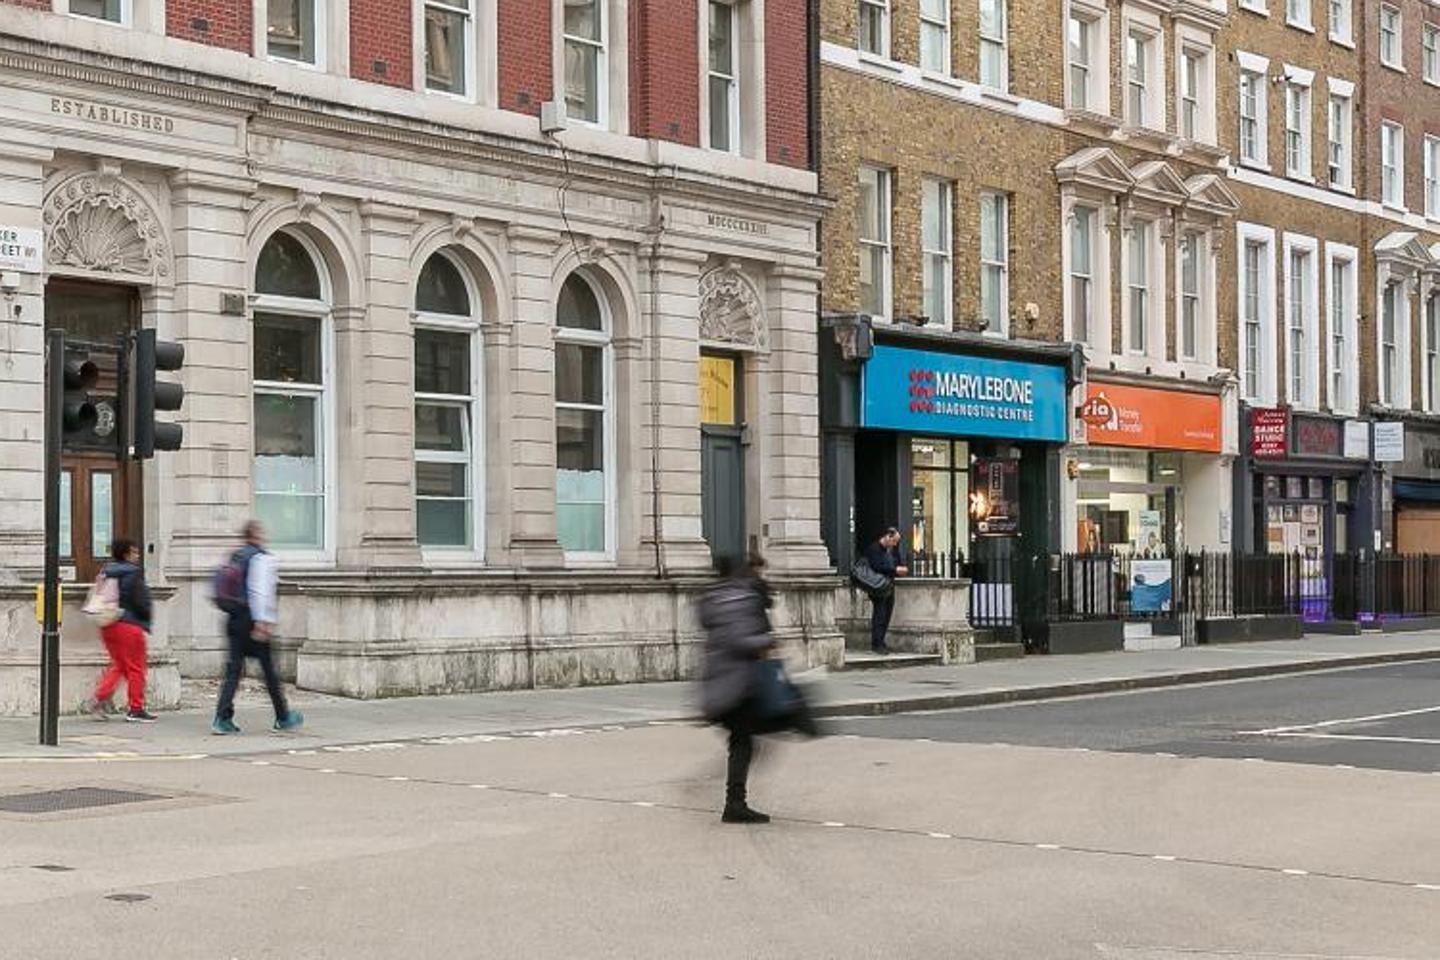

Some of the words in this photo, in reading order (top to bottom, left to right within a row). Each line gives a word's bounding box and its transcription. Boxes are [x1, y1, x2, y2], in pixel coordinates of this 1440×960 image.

[50, 98, 174, 133] ESTABLISHED
[936, 370, 1033, 404] MARYLEBONE
[935, 401, 996, 419] DIAGNOSTIC
[997, 407, 1034, 421] CENTRE
[1083, 399, 1109, 416] ria
